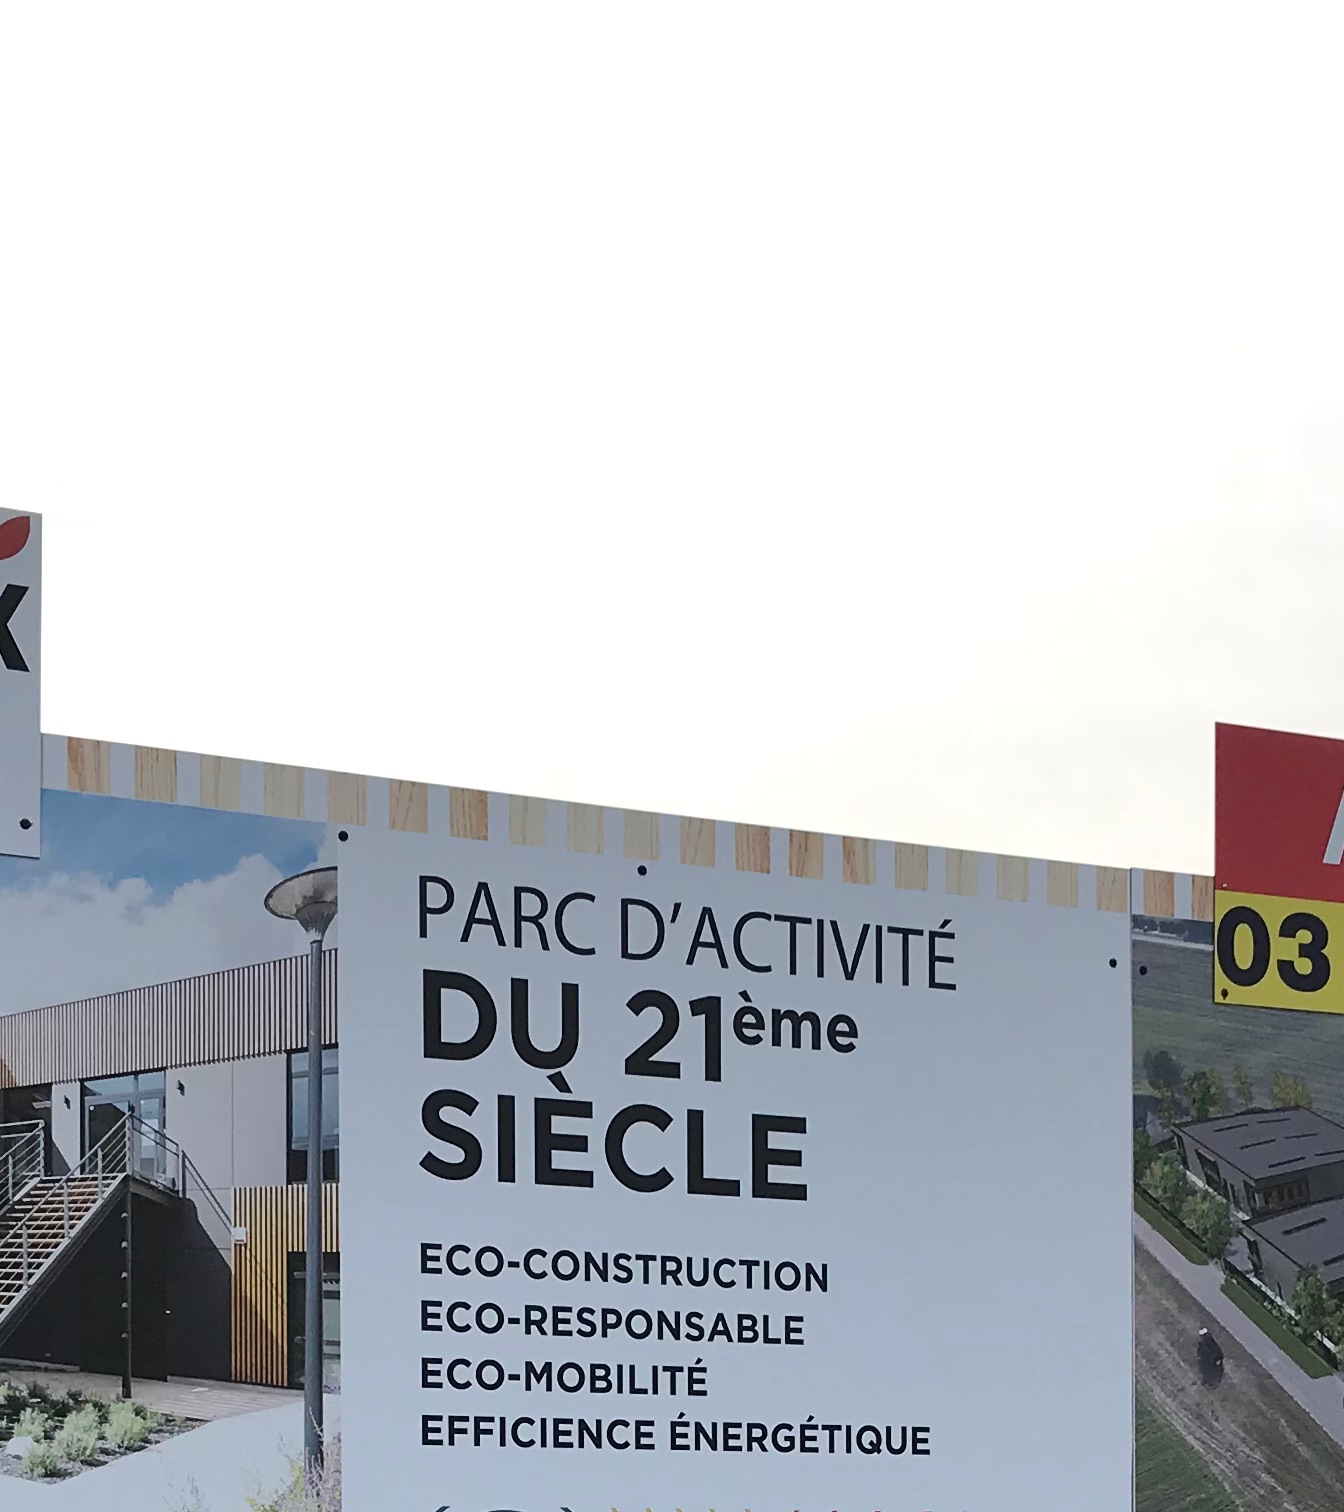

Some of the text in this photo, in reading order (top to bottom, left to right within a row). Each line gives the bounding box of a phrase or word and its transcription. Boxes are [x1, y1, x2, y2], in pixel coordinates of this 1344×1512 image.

[419, 875, 957, 991] PARC D'ACTIVITÉ
[1215, 905, 1332, 992] 03
[422, 968, 859, 1083] DU 21ème
[418, 1070, 808, 1201] SIÈCLE
[419, 1242, 829, 1293] ECO-CONSTRUCTION
[419, 1299, 806, 1346] ECO-RESPONSABLE
[419, 1357, 709, 1397] ECO-MOBILITÉ
[420, 1411, 931, 1456] EFFICIENCE ÉNERGÉTIQUE
